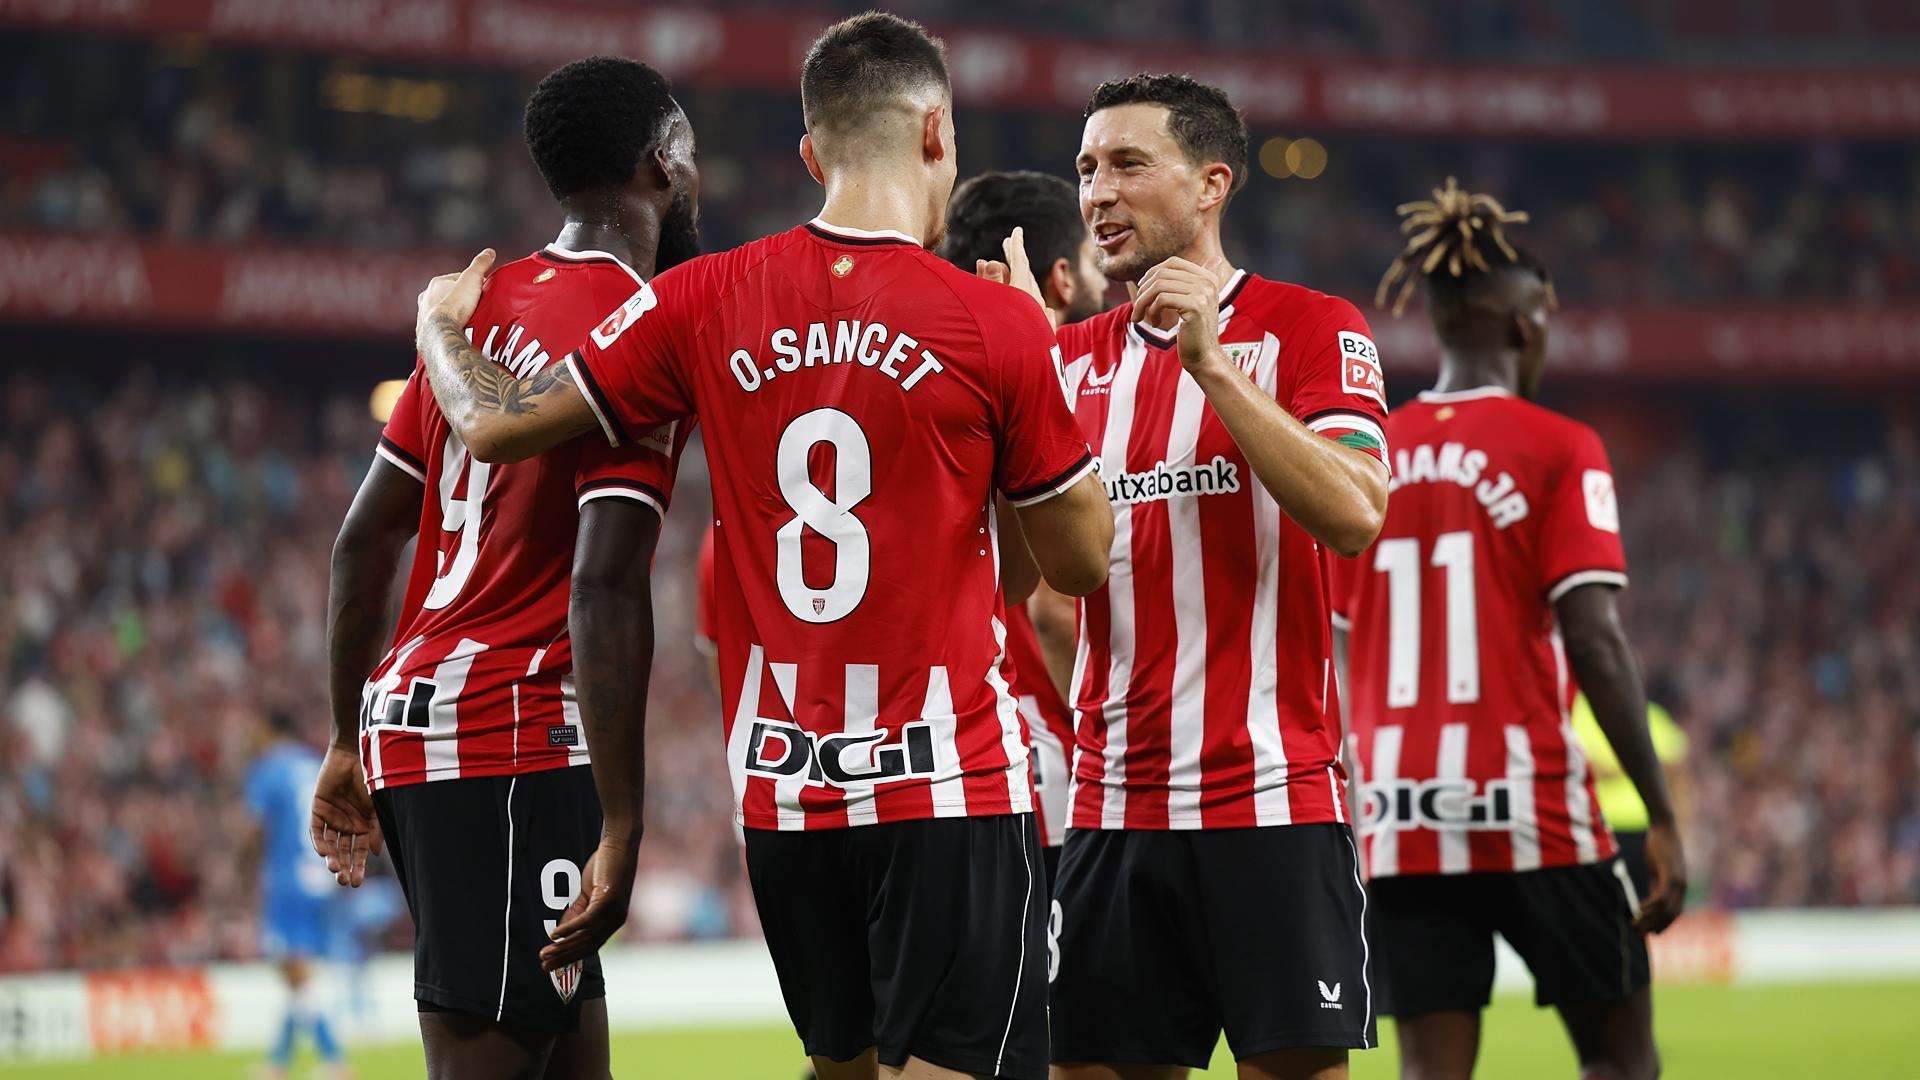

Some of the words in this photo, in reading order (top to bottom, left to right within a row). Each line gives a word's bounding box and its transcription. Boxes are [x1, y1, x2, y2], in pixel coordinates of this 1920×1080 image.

[729, 320, 943, 393] O.SANCET
[1343, 338, 1377, 364] B2B
[1352, 364, 1385, 395] PAY
[1095, 460, 1236, 501] utxabank
[1475, 471, 1529, 529] JR
[423, 428, 491, 611] 9
[777, 407, 871, 624] 8
[1374, 531, 1480, 708] 11
[745, 721, 936, 784] DIGI
[540, 858, 582, 943] 9
